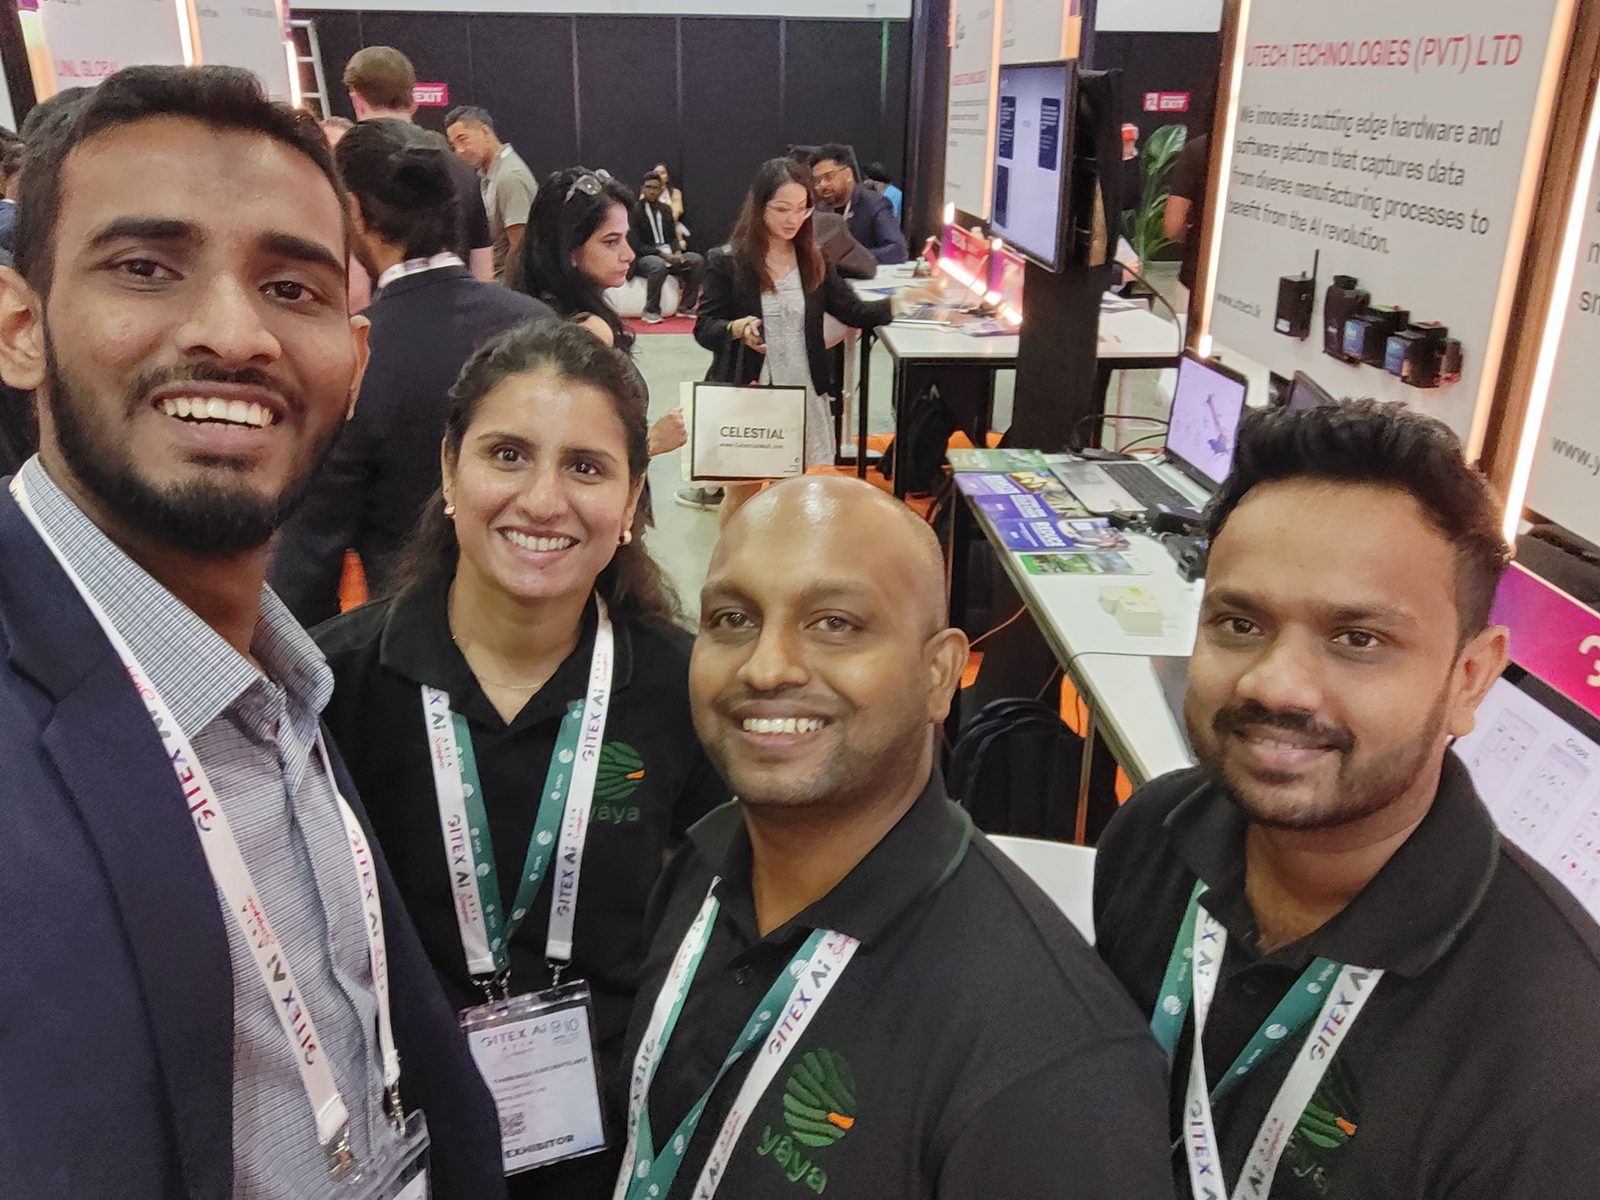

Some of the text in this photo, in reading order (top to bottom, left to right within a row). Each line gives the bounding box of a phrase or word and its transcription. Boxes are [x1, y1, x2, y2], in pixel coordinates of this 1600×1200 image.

[1291, 39, 1411, 67] TECHNOLOGIES
[1413, 33, 1472, 75] (PVT)
[1475, 34, 1523, 67] LTD
[1240, 104, 1504, 146] We innovate a cutting edge hardware and
[1235, 136, 1465, 186] software platform that captures data
[1231, 165, 1489, 235] from diverse manufacturing processes to
[1228, 200, 1390, 254] benefit from the AI revolution.
[720, 426, 785, 440] CELESTIAL
[582, 711, 601, 761] GITEX
[168, 748, 216, 832] GITEX
[350, 829, 375, 900] GITEX
[447, 814, 467, 866] GITEX
[557, 868, 575, 917] GITEX
[282, 989, 318, 1066] GITEX
[481, 1028, 527, 1048] GITEX
[768, 989, 813, 1056] GITEX
[1309, 994, 1354, 1063] GITEX
[505, 1133, 575, 1159] EXHIBITOR
[756, 1124, 828, 1195] yaya
[1189, 1098, 1214, 1176] GITEX
